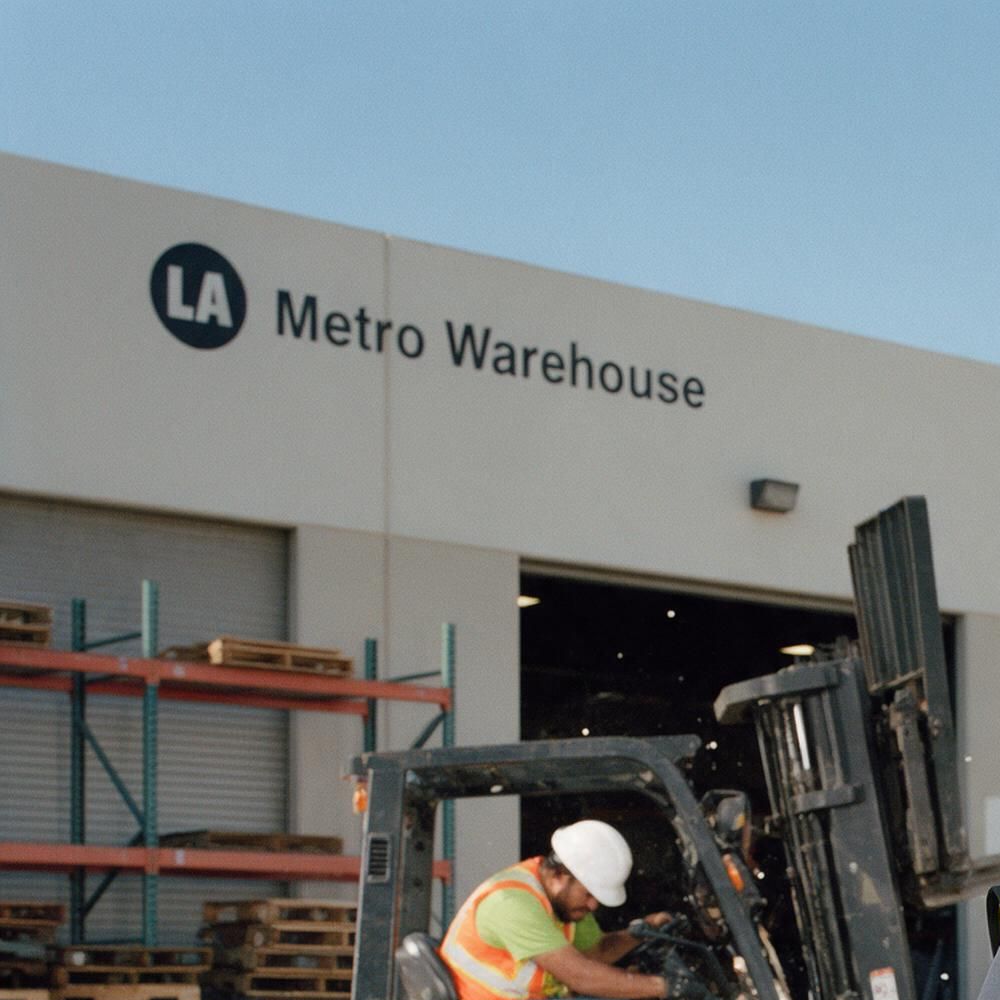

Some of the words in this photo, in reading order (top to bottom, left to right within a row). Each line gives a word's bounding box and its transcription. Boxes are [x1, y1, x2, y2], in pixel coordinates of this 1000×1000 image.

[166, 263, 234, 328] LA
[275, 289, 424, 359] Metro
[445, 320, 706, 409] Warehouse
